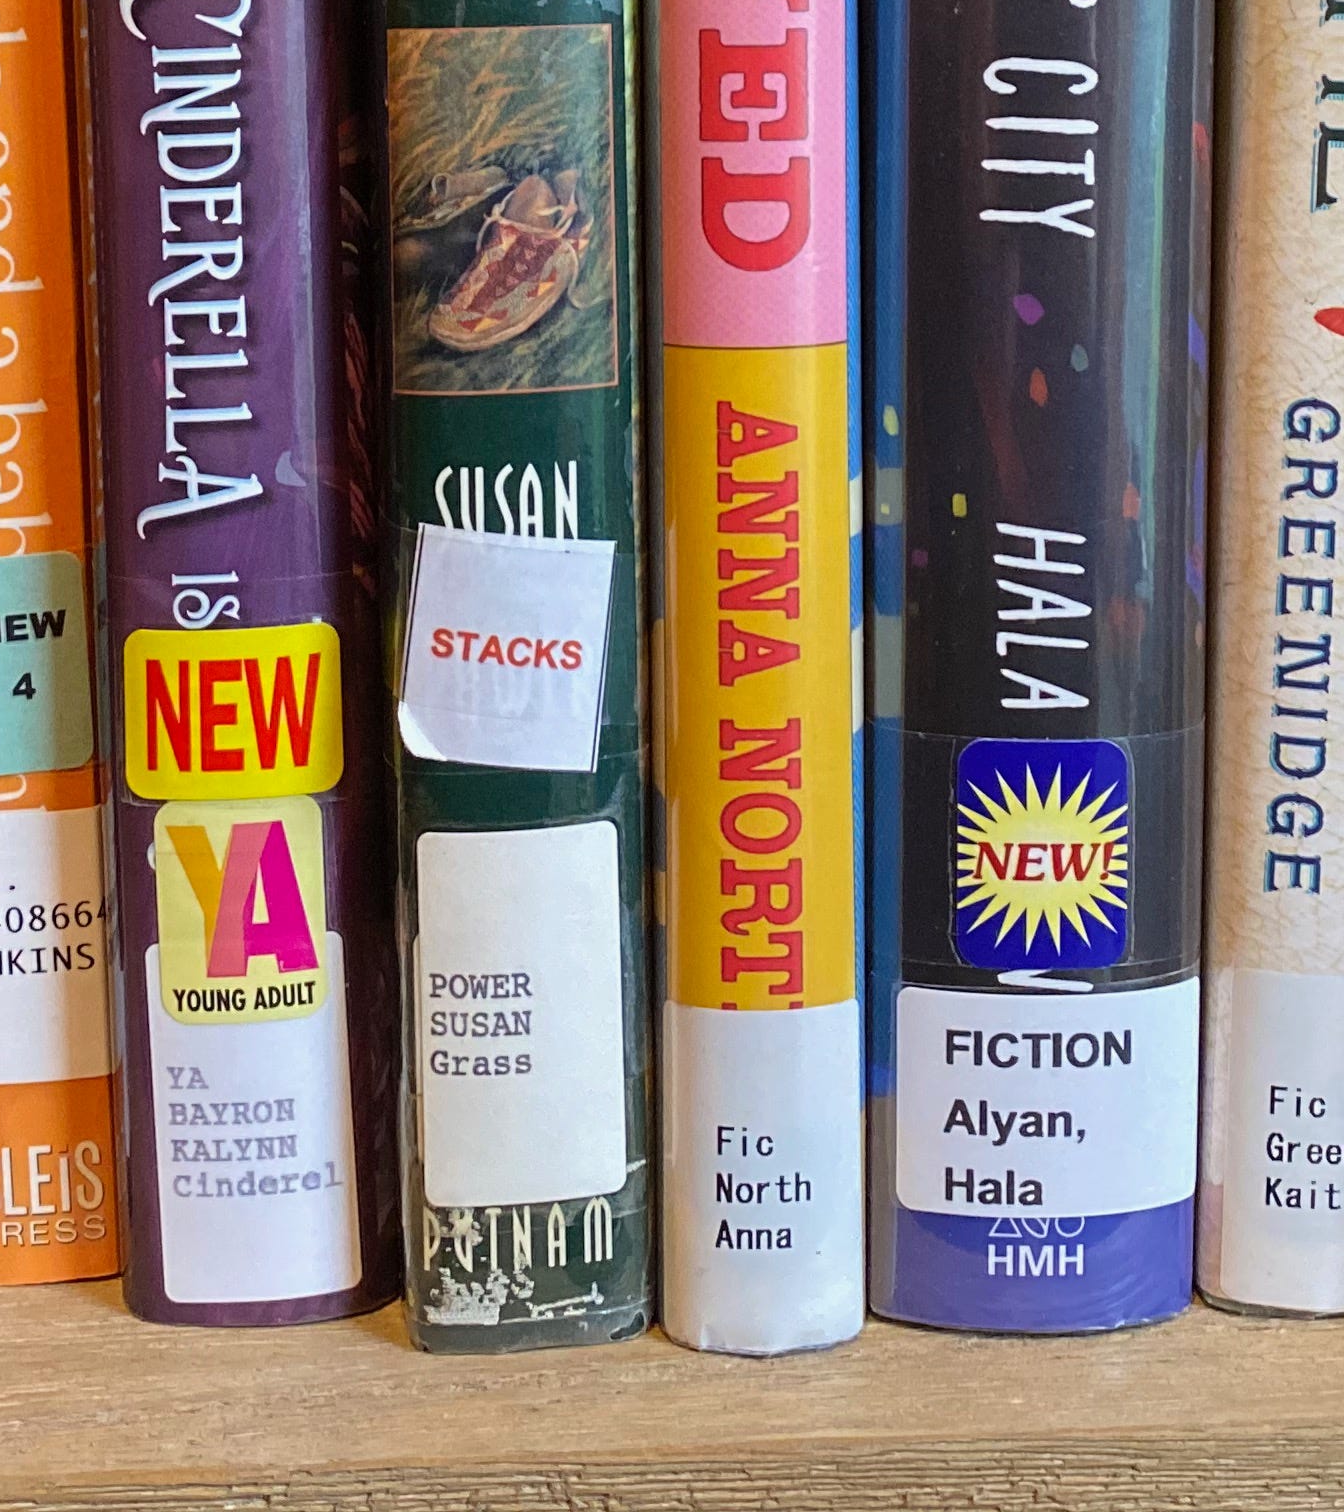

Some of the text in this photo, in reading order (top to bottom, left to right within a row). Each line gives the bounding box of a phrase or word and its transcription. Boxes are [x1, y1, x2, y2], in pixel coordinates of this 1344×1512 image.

[979, 57, 1099, 238] CITY
[434, 459, 579, 541] SUSAN
[993, 522, 1092, 709] HALA
[431, 628, 583, 670] STACKS
[1263, 396, 1341, 895] GREENIDGE
[12, 673, 36, 700] 4
[716, 400, 803, 1009] ANNA NORT
[146, 652, 321, 772] NEW
[972, 842, 1115, 881] NEW!
[165, 820, 319, 978] YA
[172, 981, 316, 1013] YOUNG ADULT
[429, 972, 533, 1000] POWER
[430, 1010, 532, 1038] SUSAN
[430, 1050, 532, 1076] Grass
[945, 1029, 1133, 1069] FICTION
[166, 1065, 209, 1091] YA
[168, 1098, 296, 1126] BAYRON
[1268, 1085, 1327, 1119] Fic
[716, 1125, 774, 1157] Fic
[943, 1098, 1086, 1147] Alyan,
[171, 1135, 298, 1163] KALYNN
[172, 1161, 344, 1199] Cinderel
[715, 1172, 812, 1204] North
[944, 1166, 1044, 1207] Hala
[423, 1196, 614, 1273] PUTNAM
[715, 1219, 793, 1250] Anna
[987, 1243, 1085, 1277] HMH
